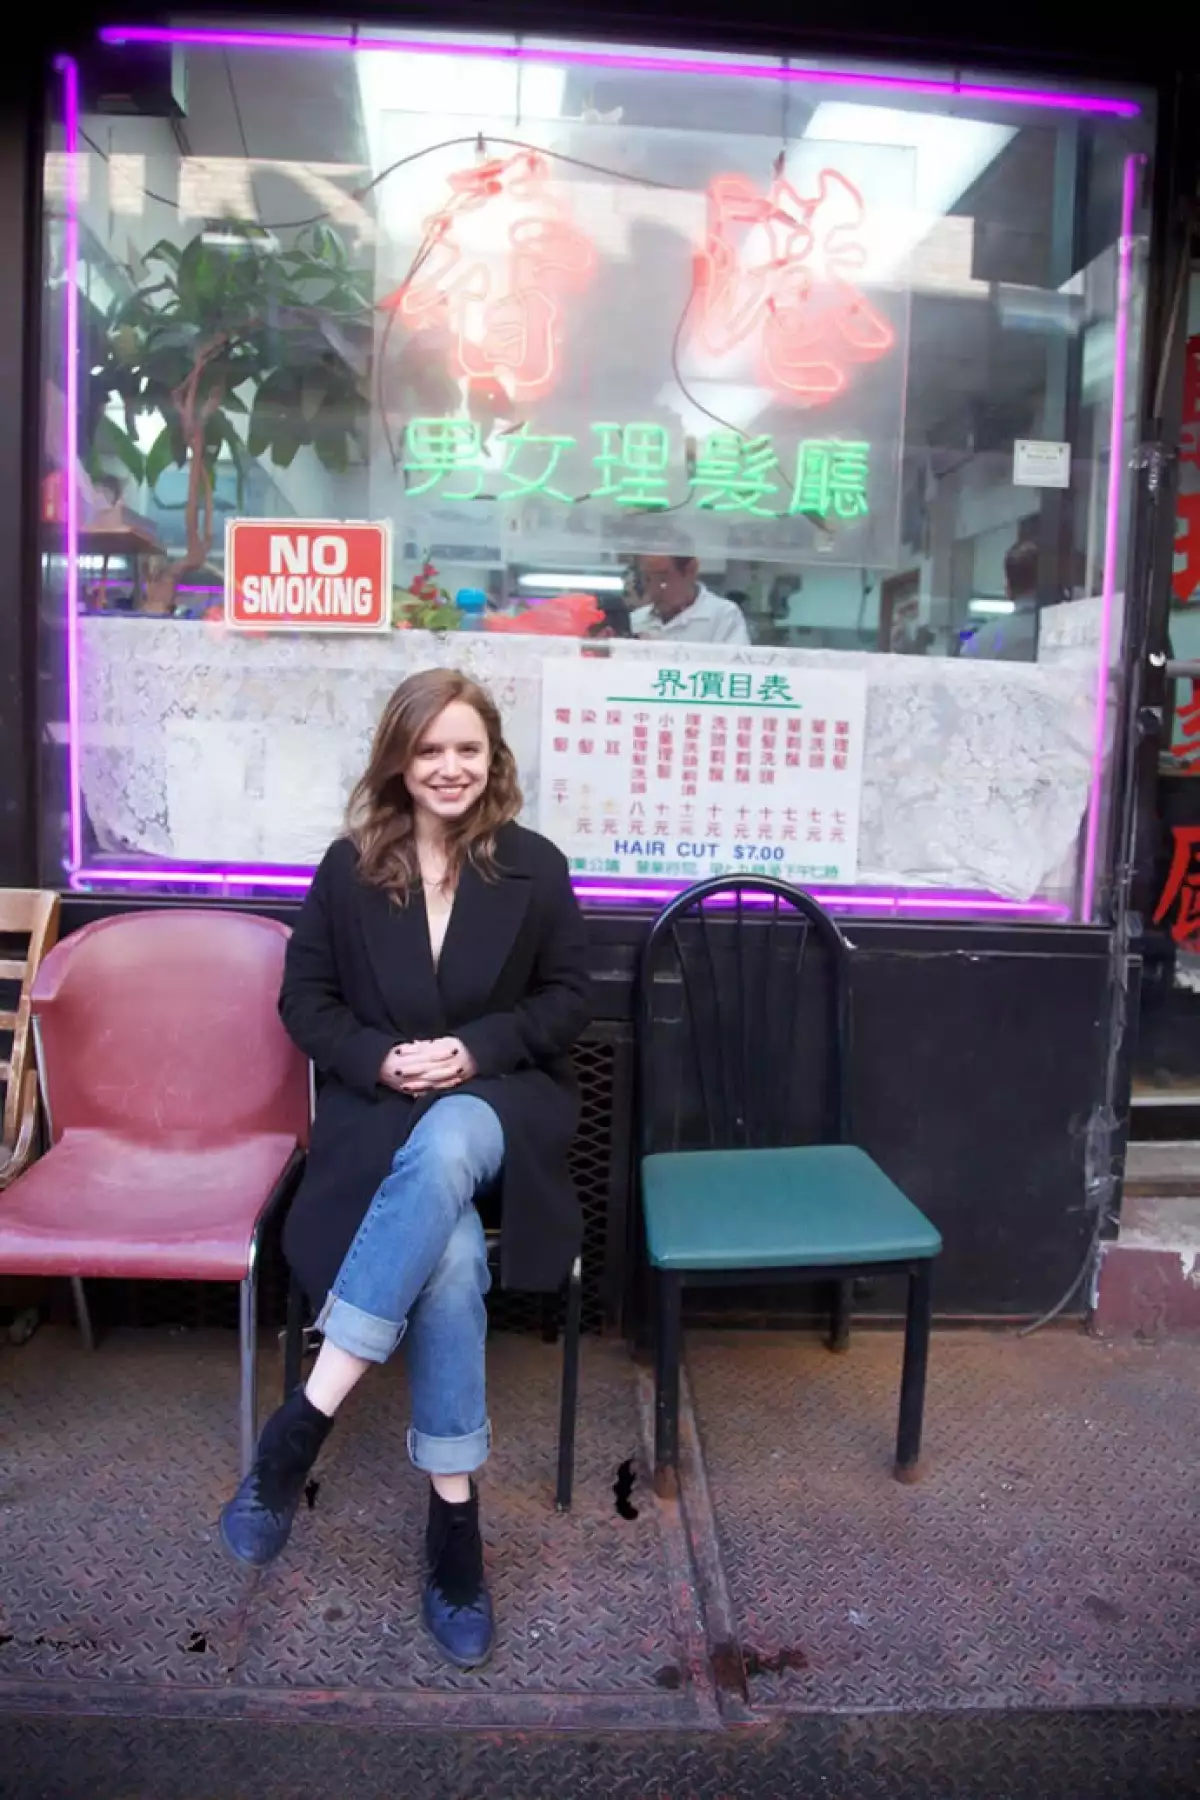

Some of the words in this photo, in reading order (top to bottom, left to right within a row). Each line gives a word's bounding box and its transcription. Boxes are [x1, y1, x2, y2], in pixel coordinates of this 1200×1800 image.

[403, 416, 871, 520] 男女理髮廳
[269, 535, 348, 575] NO
[242, 575, 373, 616] SMOKING
[614, 840, 665, 857] HAIR
[677, 842, 720, 858] CUT
[733, 844, 786, 861] $7.00
